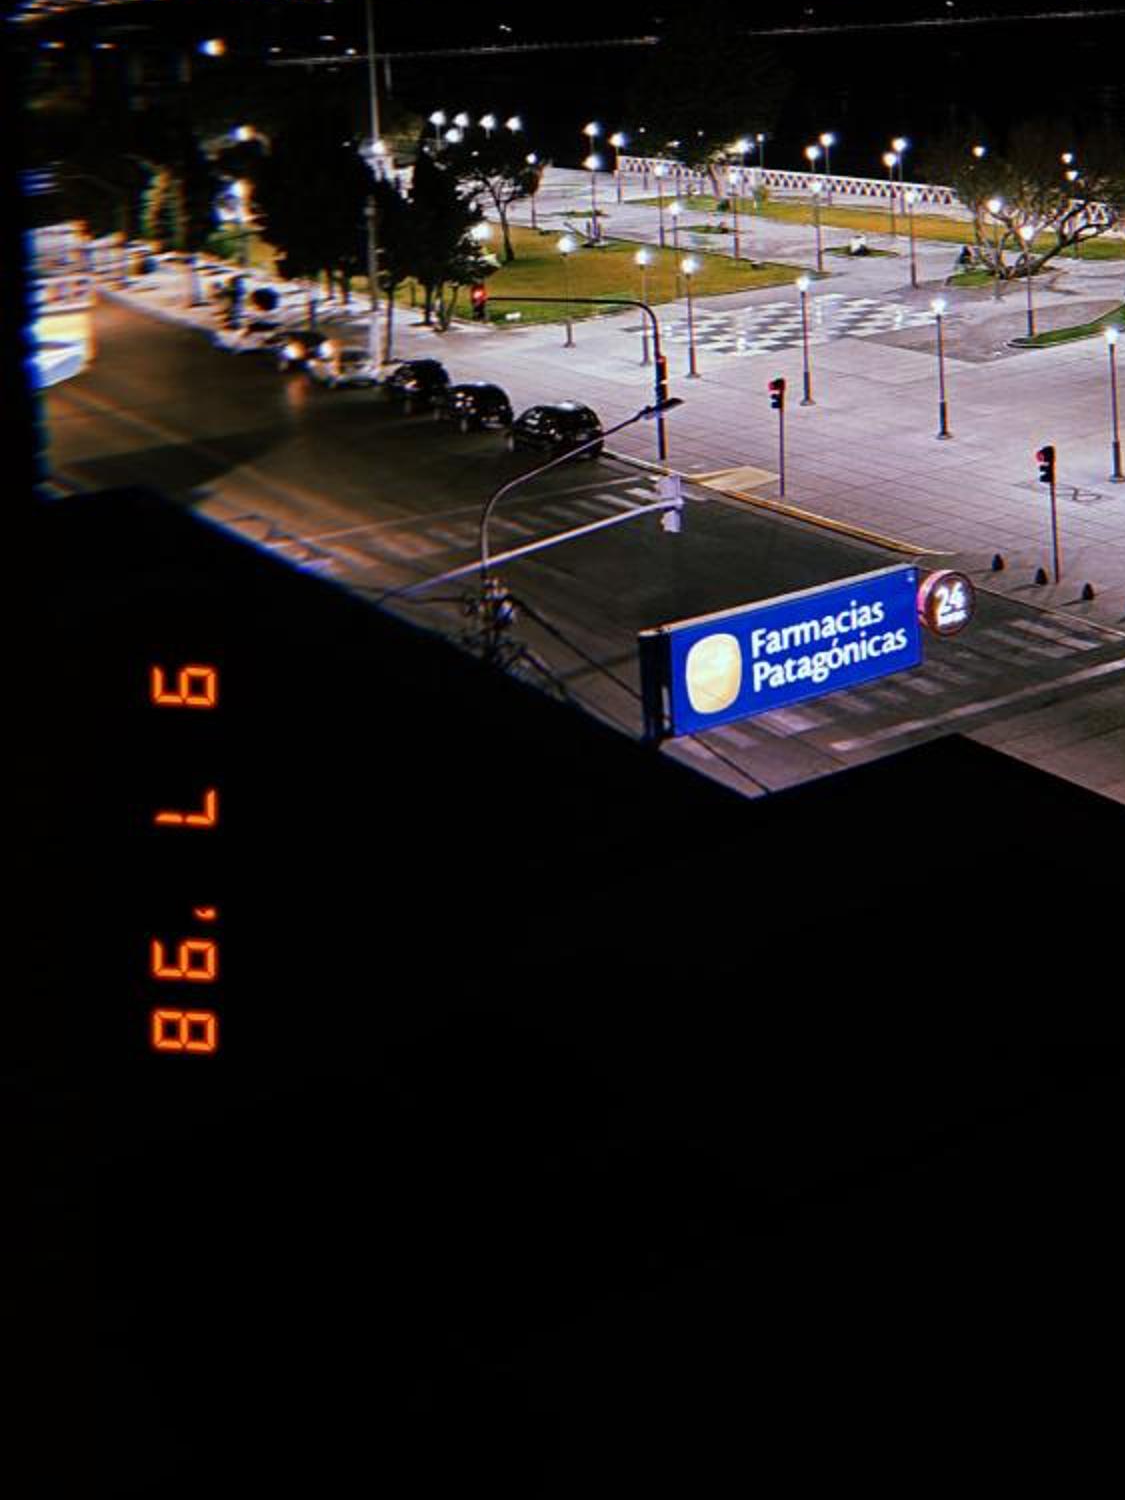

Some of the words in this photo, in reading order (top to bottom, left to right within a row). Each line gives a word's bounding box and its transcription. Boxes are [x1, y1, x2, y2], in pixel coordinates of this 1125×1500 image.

[934, 581, 966, 615] 24
[751, 600, 885, 659] Farmacias
[753, 627, 908, 693] Patagónicas
